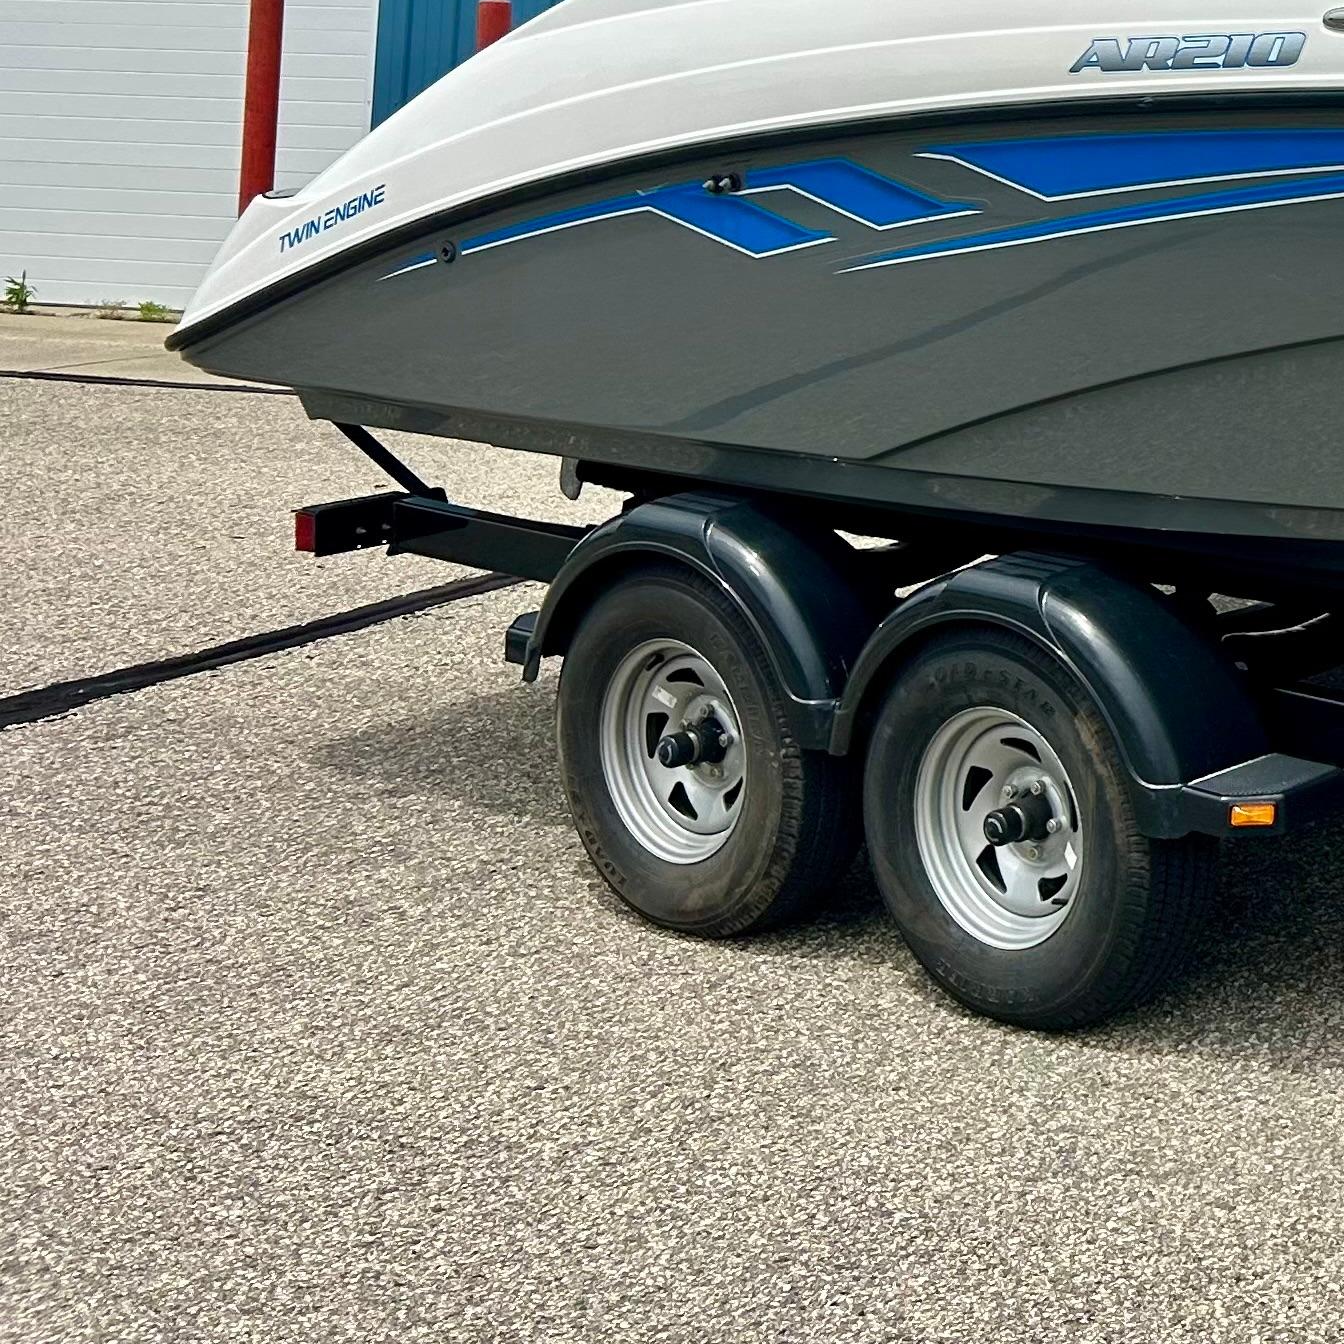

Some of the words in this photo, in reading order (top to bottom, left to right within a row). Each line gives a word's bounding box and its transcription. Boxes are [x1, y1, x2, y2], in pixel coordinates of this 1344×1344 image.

[1068, 31, 1308, 74] AR210
[279, 216, 322, 253] TWIN
[323, 184, 386, 230] ENGINE
